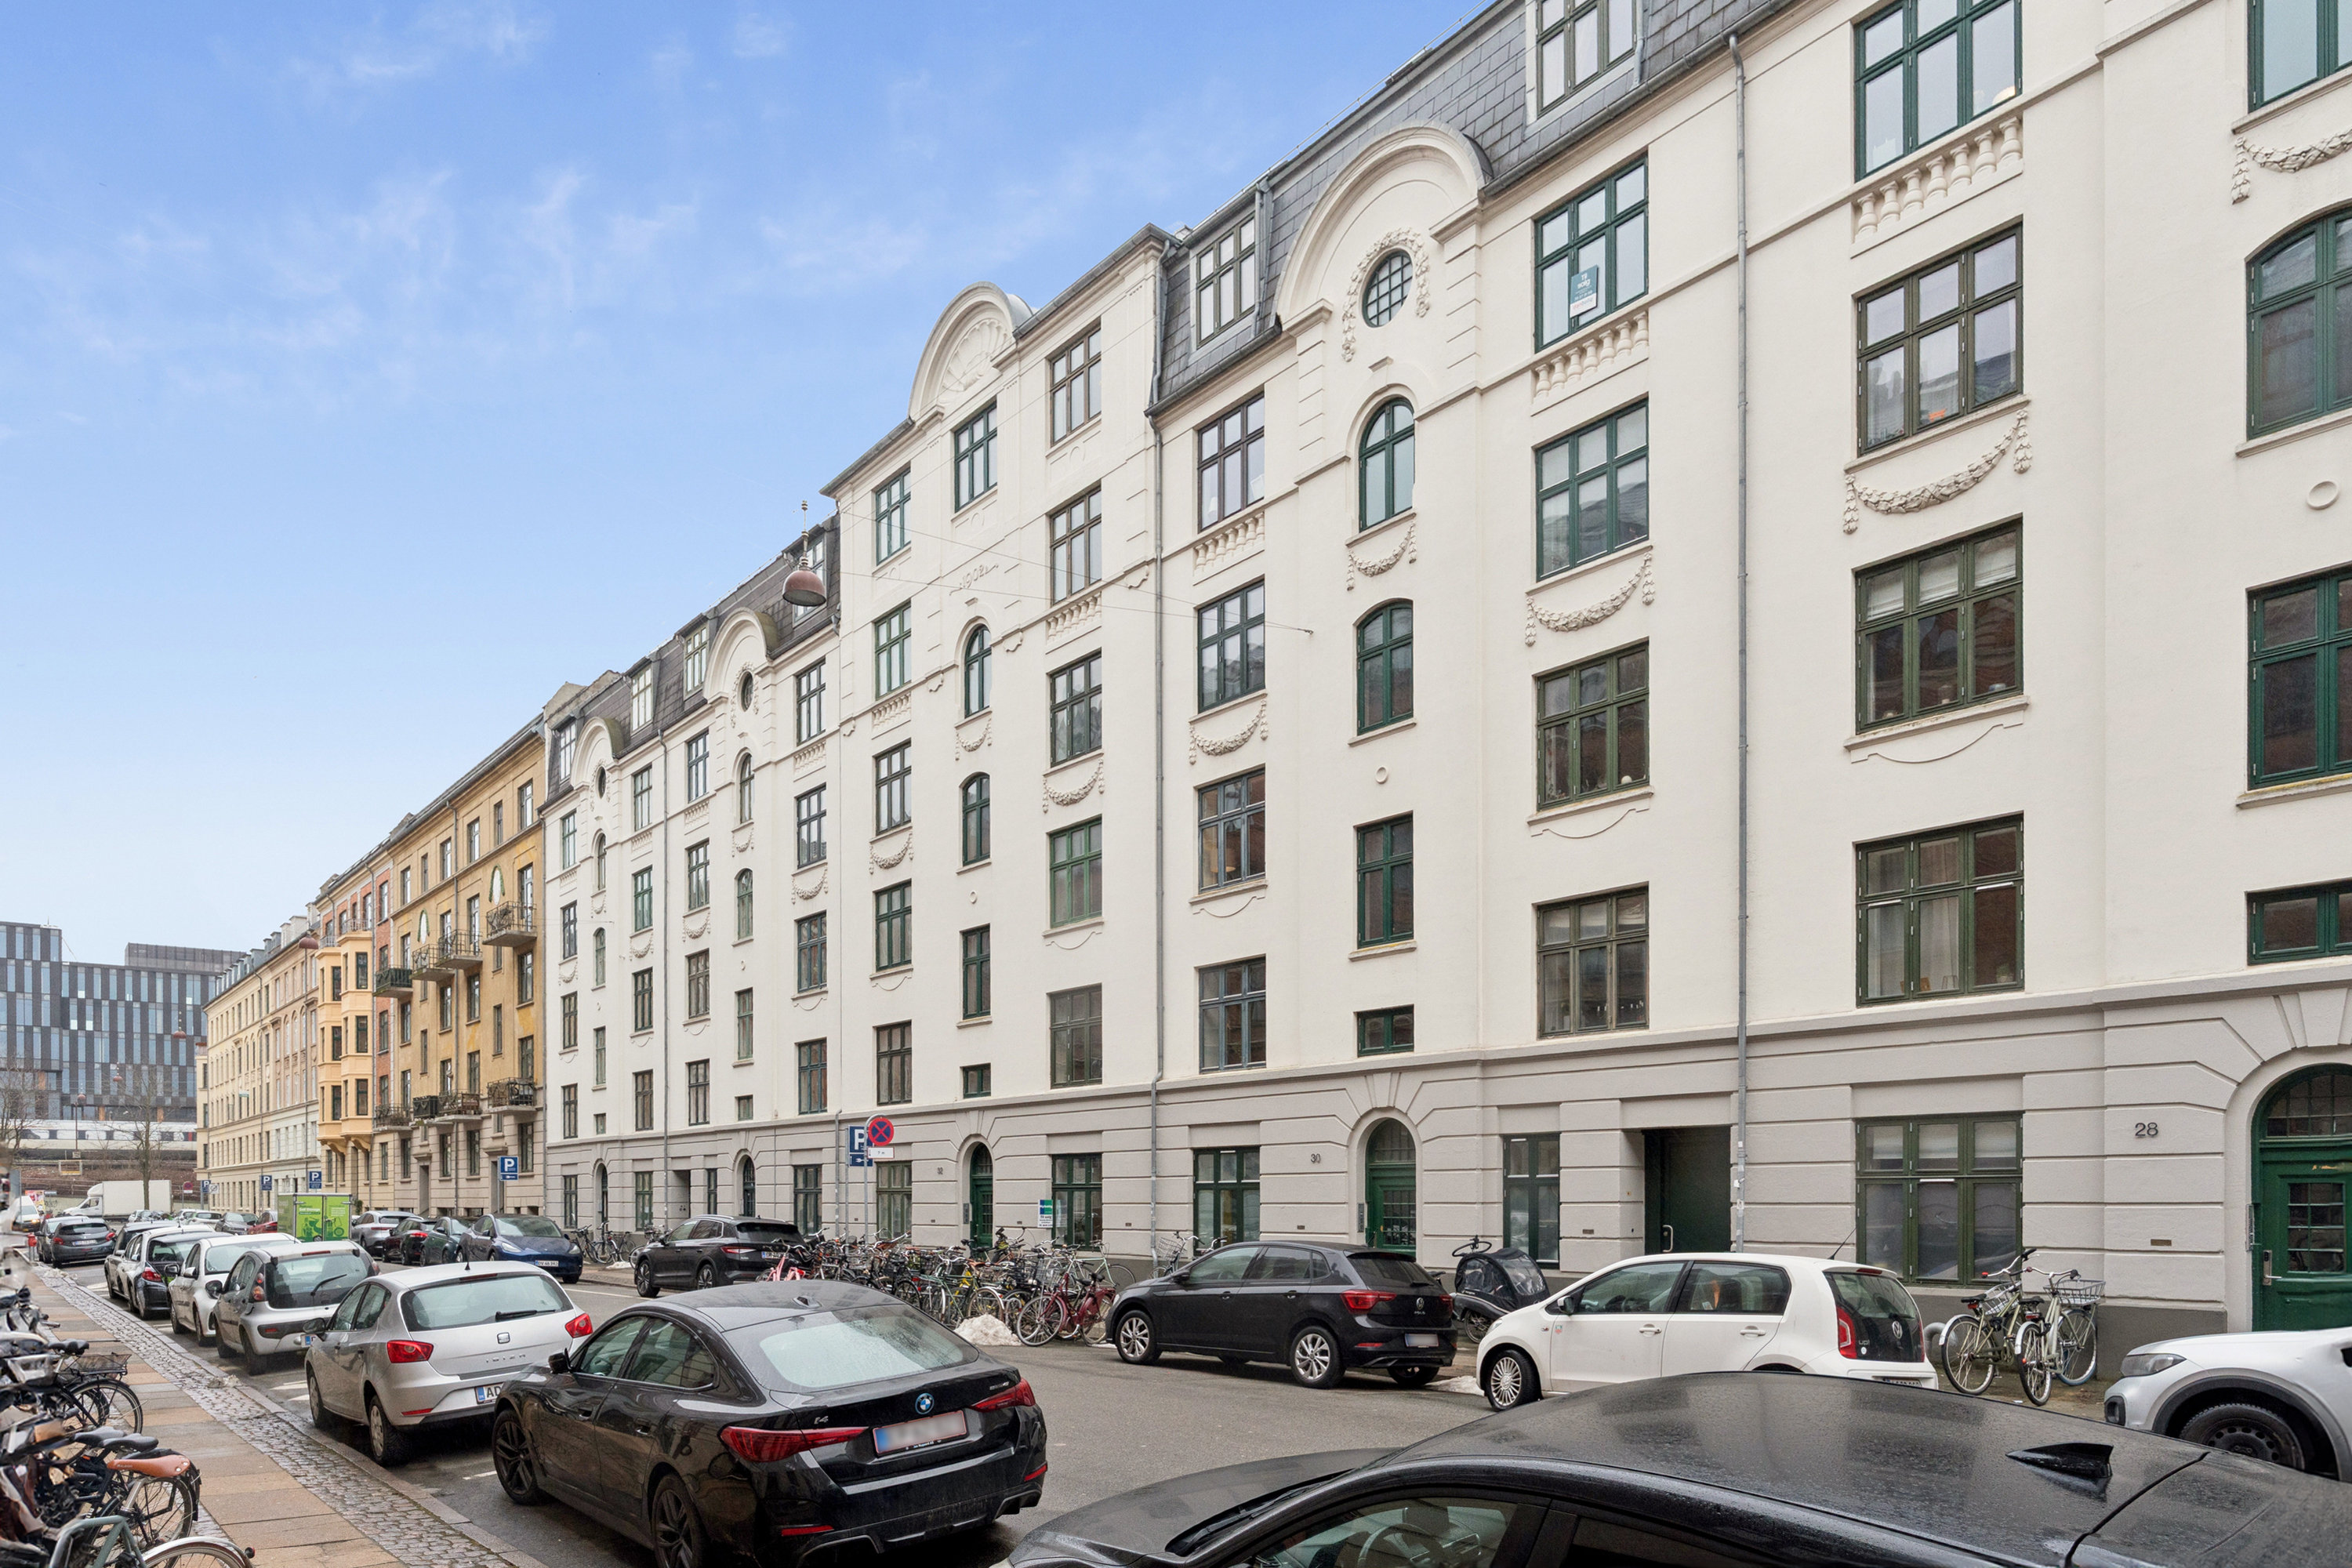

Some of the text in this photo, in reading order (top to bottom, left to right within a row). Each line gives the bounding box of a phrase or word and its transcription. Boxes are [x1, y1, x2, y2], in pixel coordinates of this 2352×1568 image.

[2135, 1122, 2159, 1137] 28
[855, 1129, 868, 1150] P
[1311, 1153, 1321, 1163] 30
[504, 1158, 515, 1172] P
[263, 1176, 270, 1185] P
[312, 1172, 319, 1181] P
